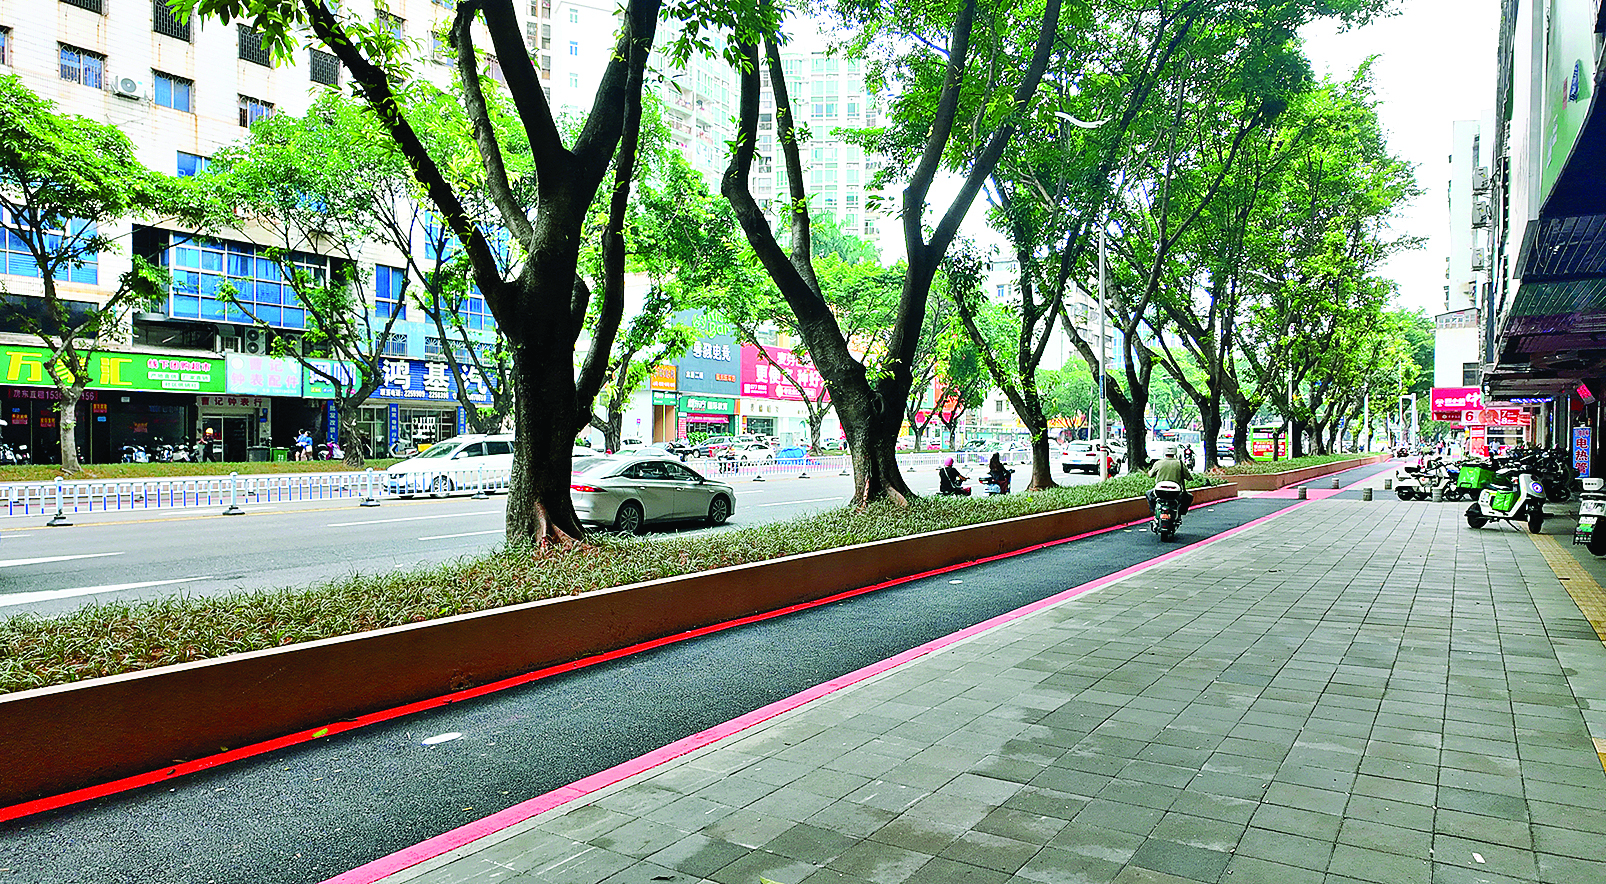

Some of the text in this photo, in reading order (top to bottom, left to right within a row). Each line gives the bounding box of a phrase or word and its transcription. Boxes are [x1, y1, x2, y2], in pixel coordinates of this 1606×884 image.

[231, 372, 299, 389] 钟表配件
[201, 396, 262, 407] 曹记钟表行
[1465, 411, 1474, 422] 6
